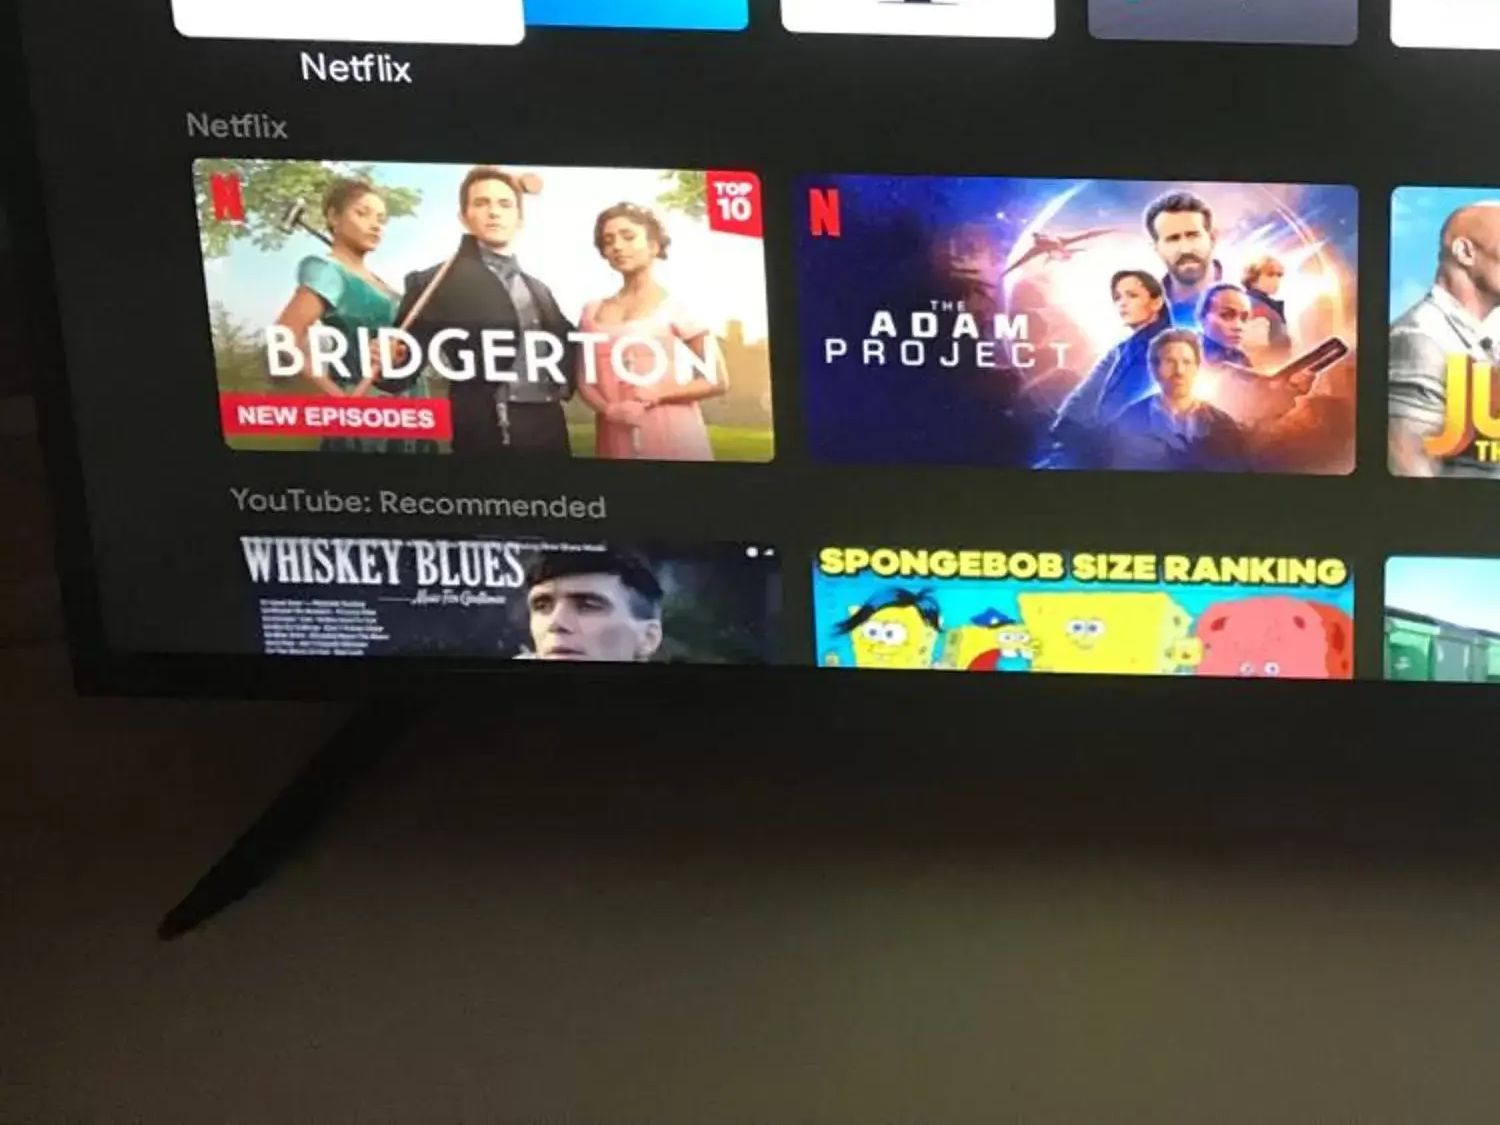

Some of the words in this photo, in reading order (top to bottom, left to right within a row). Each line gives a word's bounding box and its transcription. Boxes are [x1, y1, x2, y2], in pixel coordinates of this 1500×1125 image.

[300, 52, 412, 84] Netflix
[187, 112, 288, 140] Netflix
[715, 181, 753, 197] TOP
[716, 197, 751, 222] 10
[930, 299, 966, 311] THE
[870, 311, 1029, 339] ADAM
[265, 325, 719, 386] BRIDGERTON
[824, 337, 1072, 370] PROJECT
[237, 405, 301, 428] NEW
[305, 406, 435, 430] EPISODES
[230, 487, 371, 515] YouTube:
[381, 490, 606, 520] Recommended
[240, 536, 403, 586] WHISKEY
[413, 539, 526, 589] BLUES
[819, 547, 1064, 581] SPONGEBOB
[1072, 552, 1157, 582] SIZE
[1163, 555, 1347, 587] RANKING
